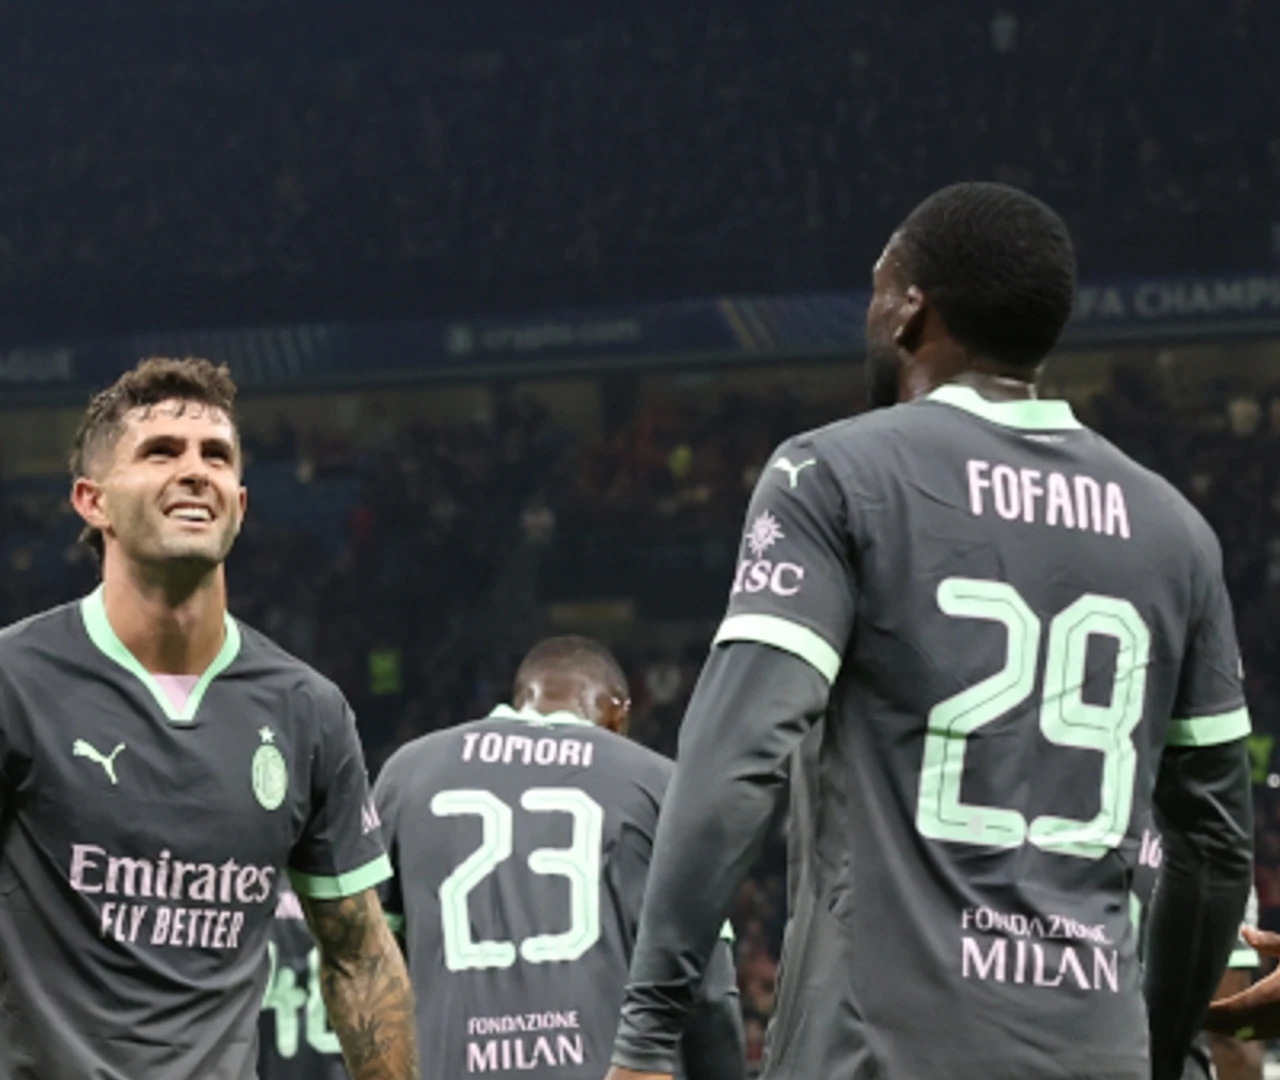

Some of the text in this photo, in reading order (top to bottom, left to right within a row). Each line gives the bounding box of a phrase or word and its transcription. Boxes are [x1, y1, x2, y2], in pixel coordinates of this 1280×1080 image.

[966, 459, 1130, 539] FOFANA
[916, 577, 1150, 860] 29
[462, 732, 593, 767] TOMORI
[70, 844, 275, 903] Emirates
[430, 787, 604, 971] 23
[100, 902, 148, 943] FLY
[150, 905, 244, 948] BETTER
[962, 937, 1118, 993] MILAN
[467, 1010, 580, 1036] FONDAZIONE
[467, 1034, 584, 1073] MILAN
